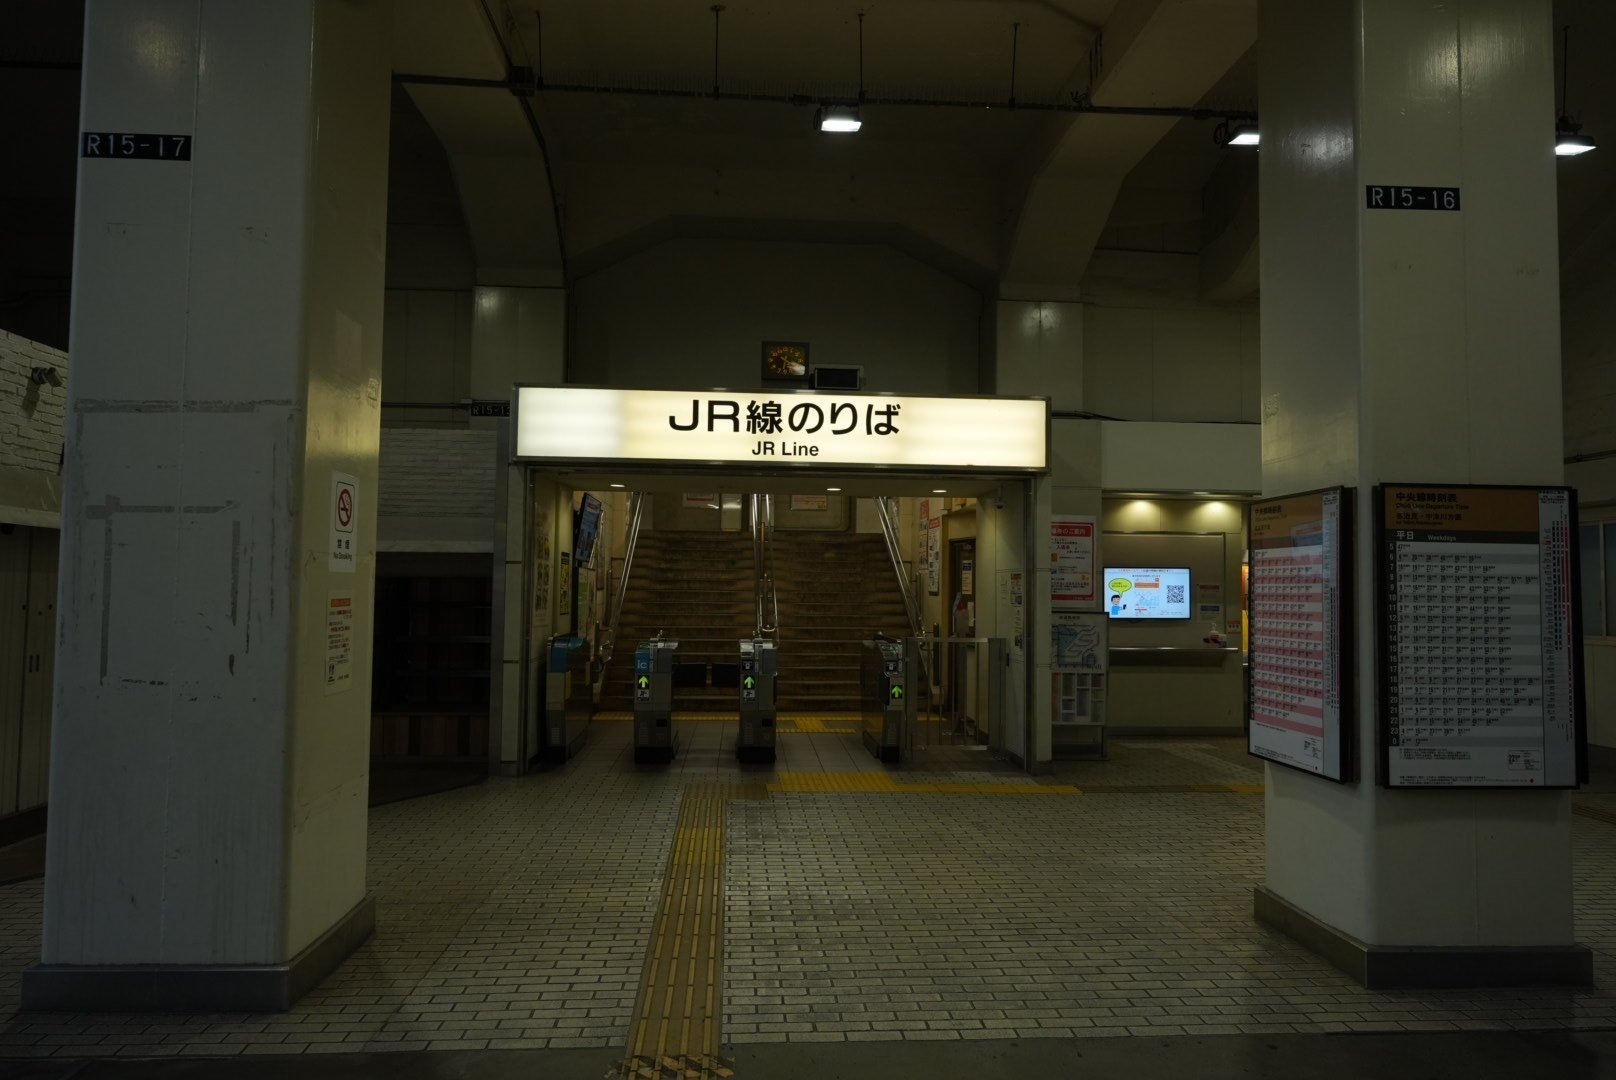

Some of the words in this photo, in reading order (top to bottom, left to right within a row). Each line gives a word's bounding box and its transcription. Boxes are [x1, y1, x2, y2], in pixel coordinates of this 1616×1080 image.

[87, 134, 185, 157] R15-17
[1372, 187, 1455, 209] R15-16
[668, 399, 901, 436] JR線のりば
[751, 441, 775, 456] JR
[782, 441, 819, 456] Line
[1396, 531, 1414, 541] 平日
